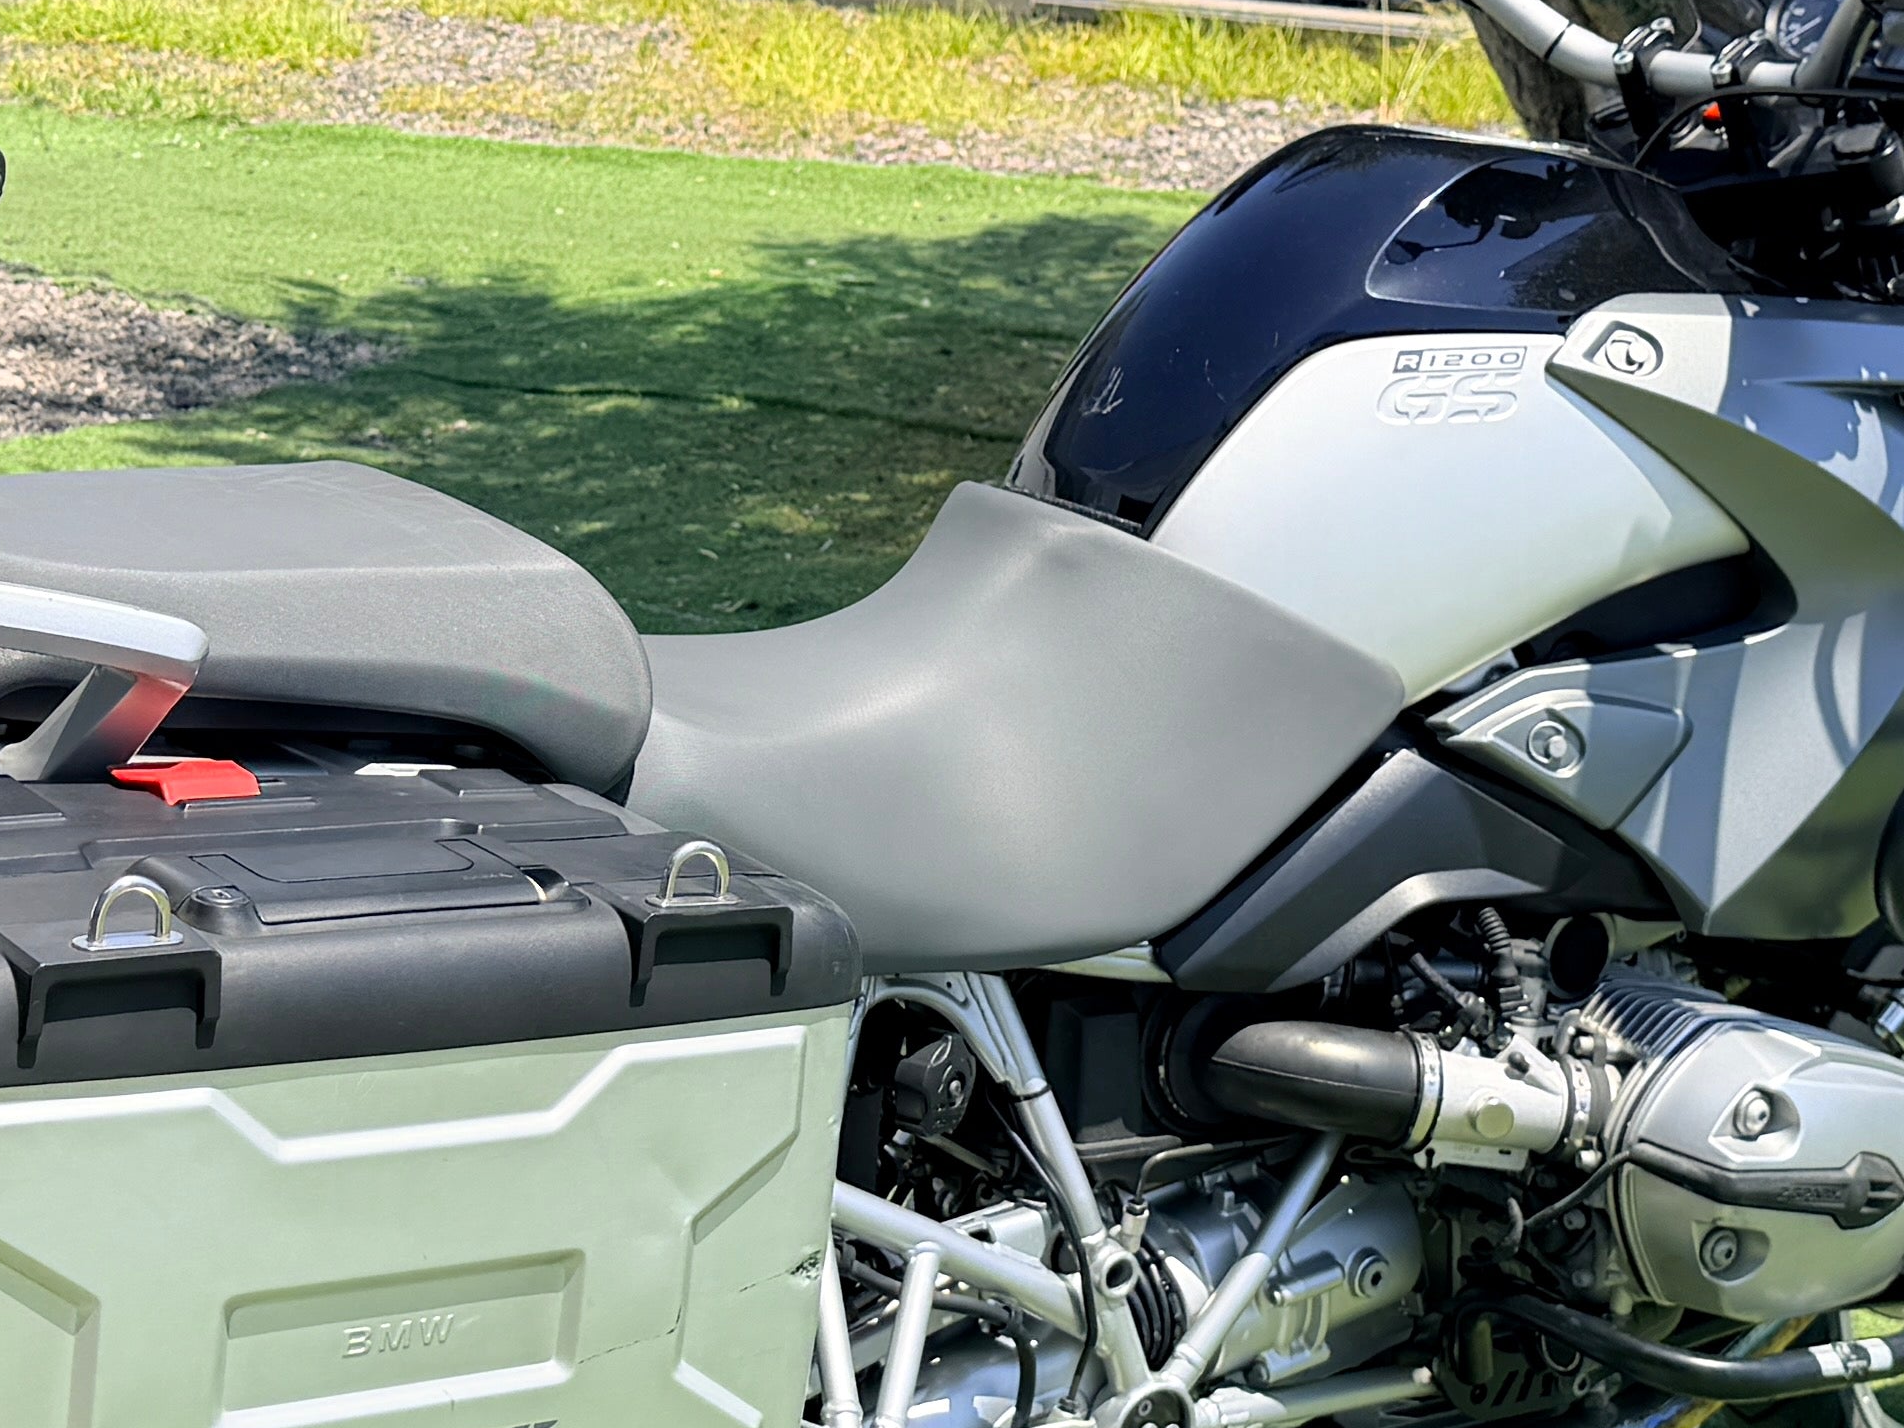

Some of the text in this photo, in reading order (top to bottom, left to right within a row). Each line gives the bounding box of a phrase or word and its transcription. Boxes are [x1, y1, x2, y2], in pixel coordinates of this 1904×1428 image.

[1395, 347, 1524, 373] R1200
[1375, 372, 1521, 425] GS
[342, 1313, 455, 1360] BMW
